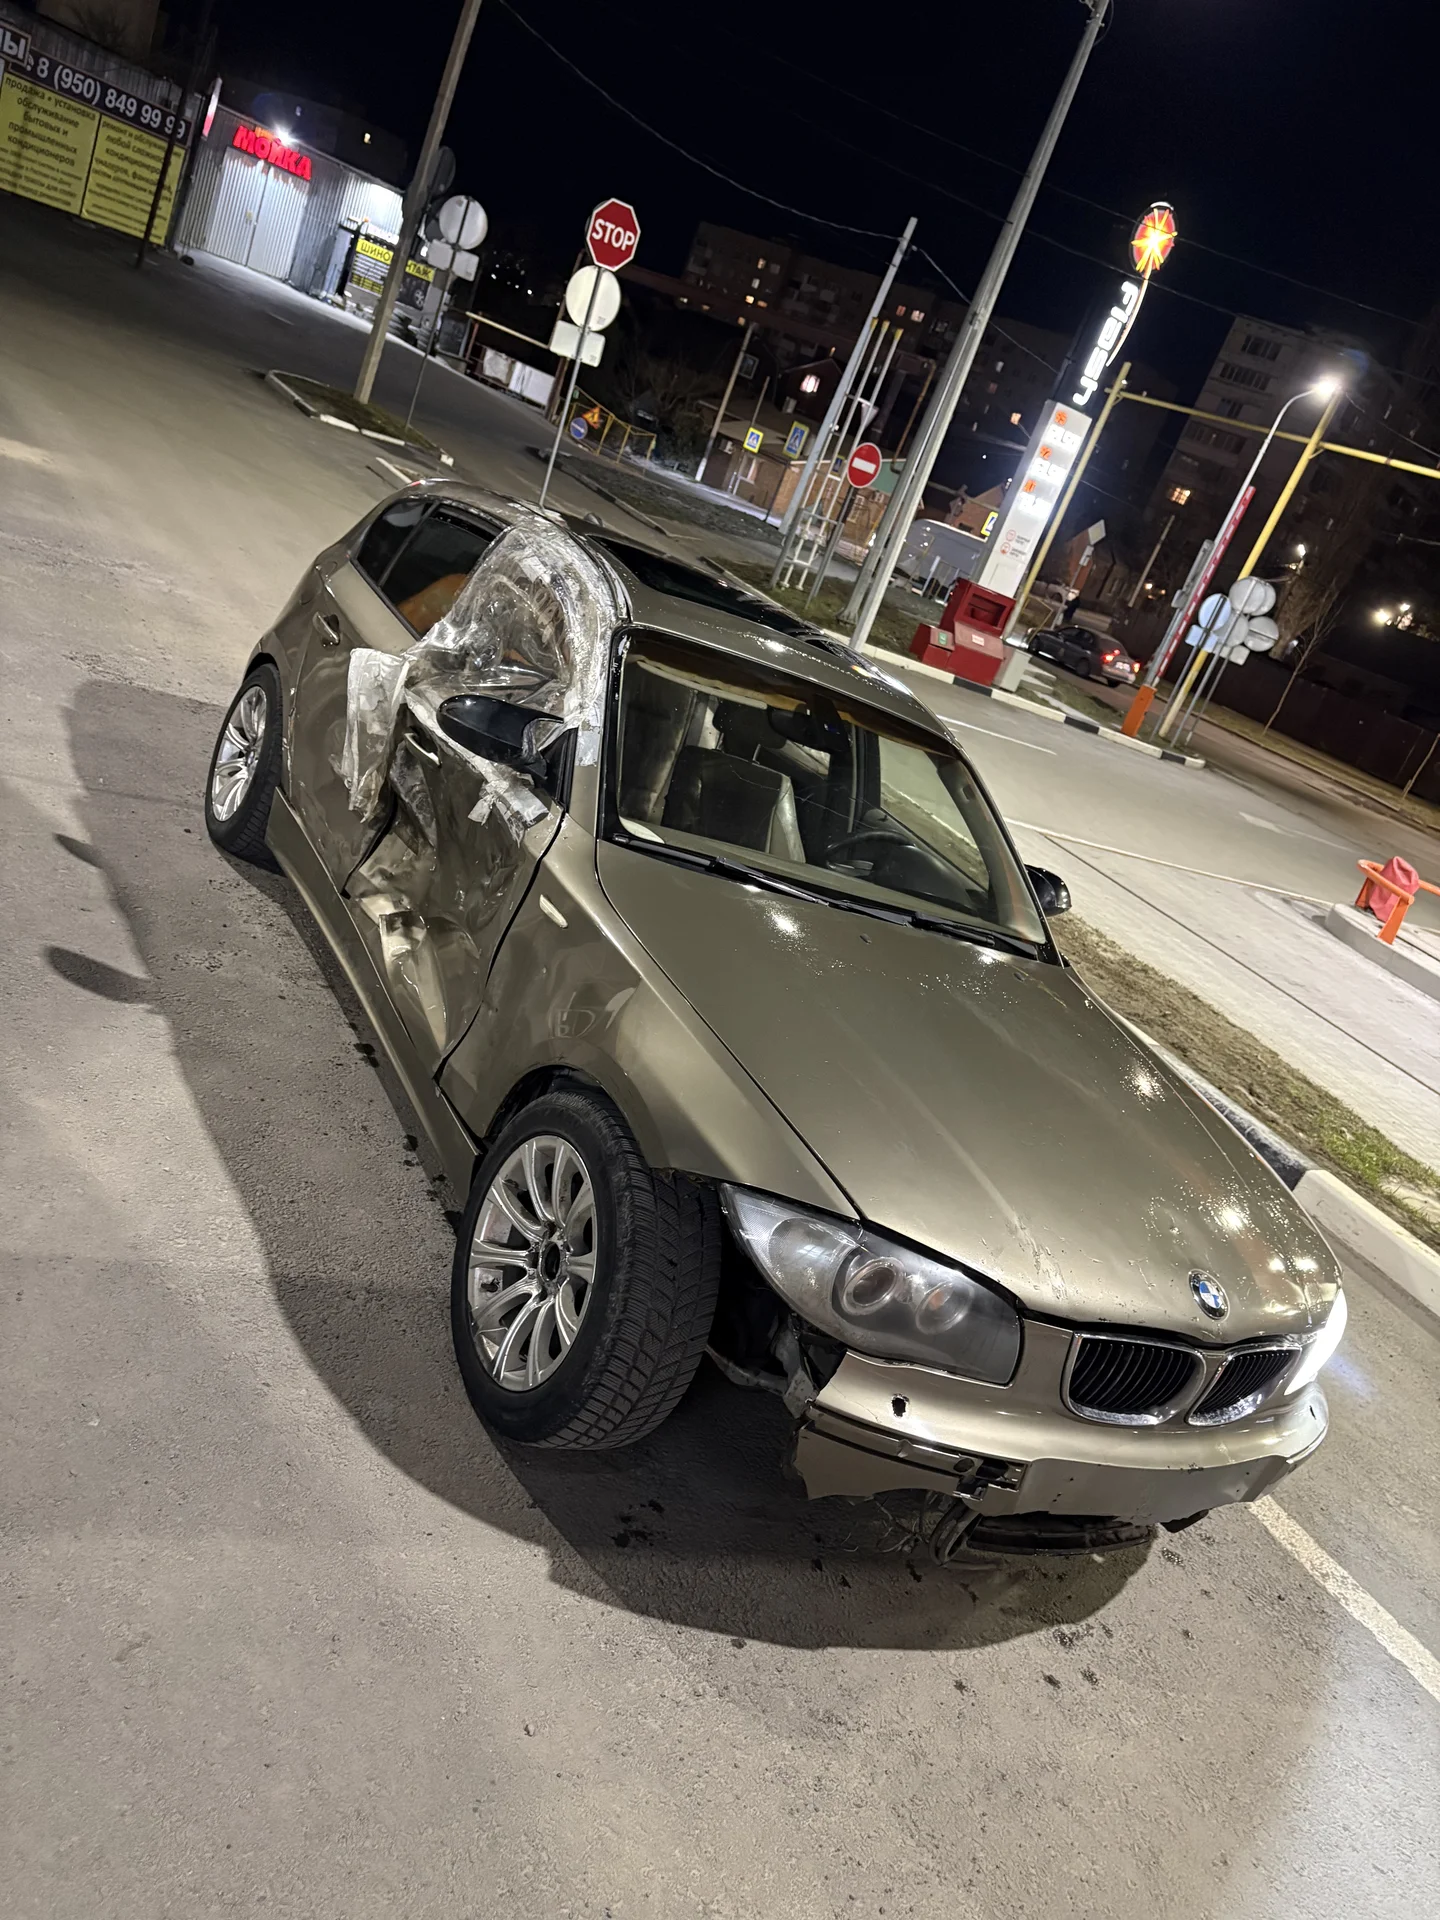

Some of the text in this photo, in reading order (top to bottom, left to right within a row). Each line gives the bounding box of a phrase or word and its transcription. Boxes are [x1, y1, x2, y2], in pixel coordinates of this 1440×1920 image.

[5, 77, 46, 100] продажа
[37, 57, 50, 79] 8
[54, 64, 101, 106] (950)
[105, 89, 137, 117] 849
[140, 105, 162, 129] 99
[232, 125, 312, 181] МОЙКА
[591, 218, 635, 251] STOP
